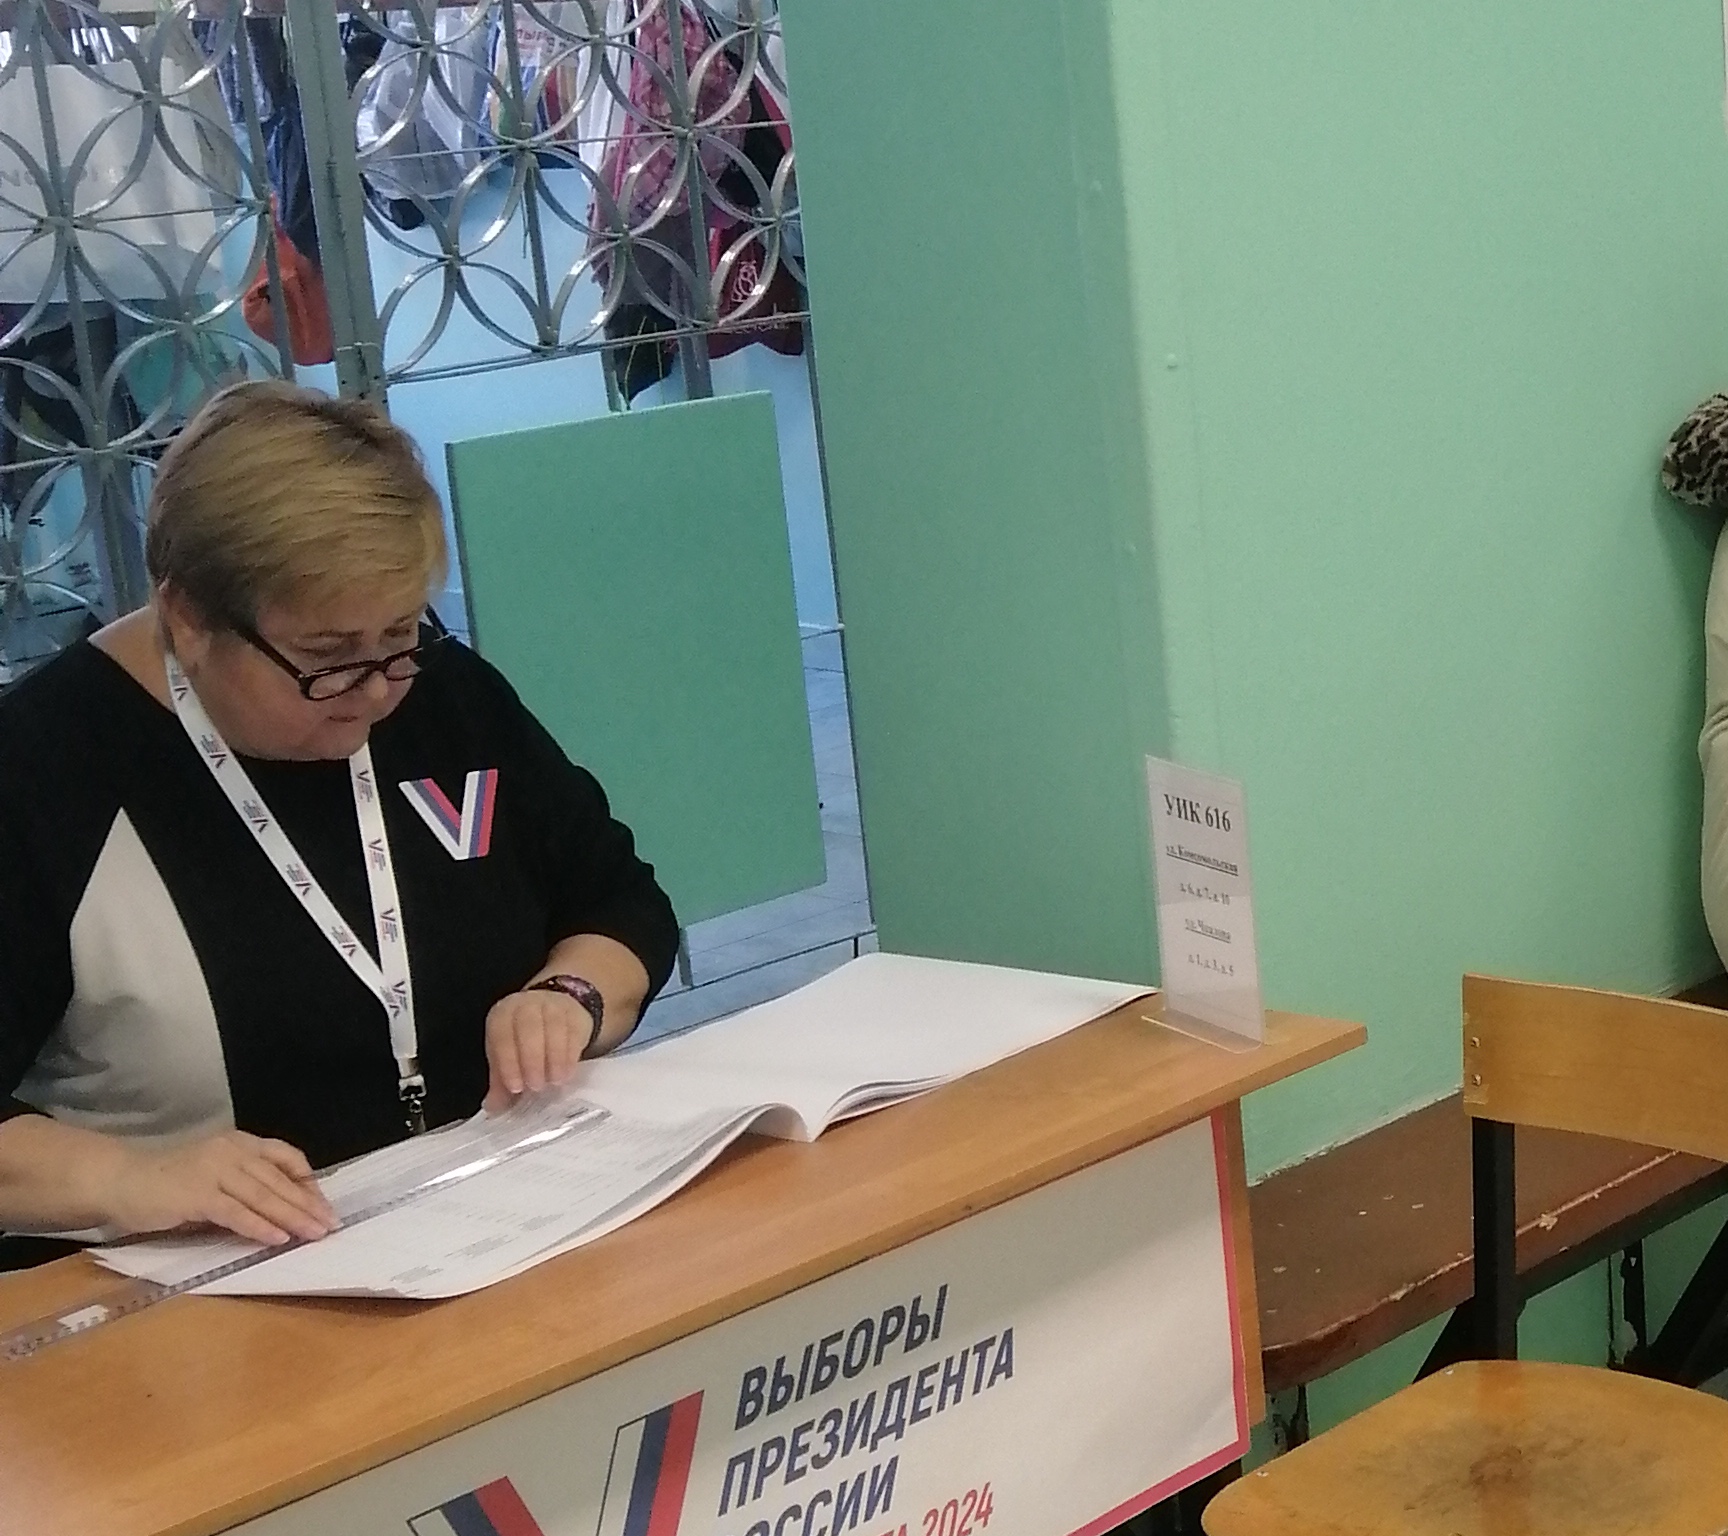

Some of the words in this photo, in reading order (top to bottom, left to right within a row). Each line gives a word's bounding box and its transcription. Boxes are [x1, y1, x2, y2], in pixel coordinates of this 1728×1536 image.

[1163, 793, 1201, 825] УИК
[1205, 806, 1231, 833] 616
[717, 1326, 1015, 1517] ПРЕЗИДЕНТА
[734, 1284, 950, 1431] ВЫБОРЫ
